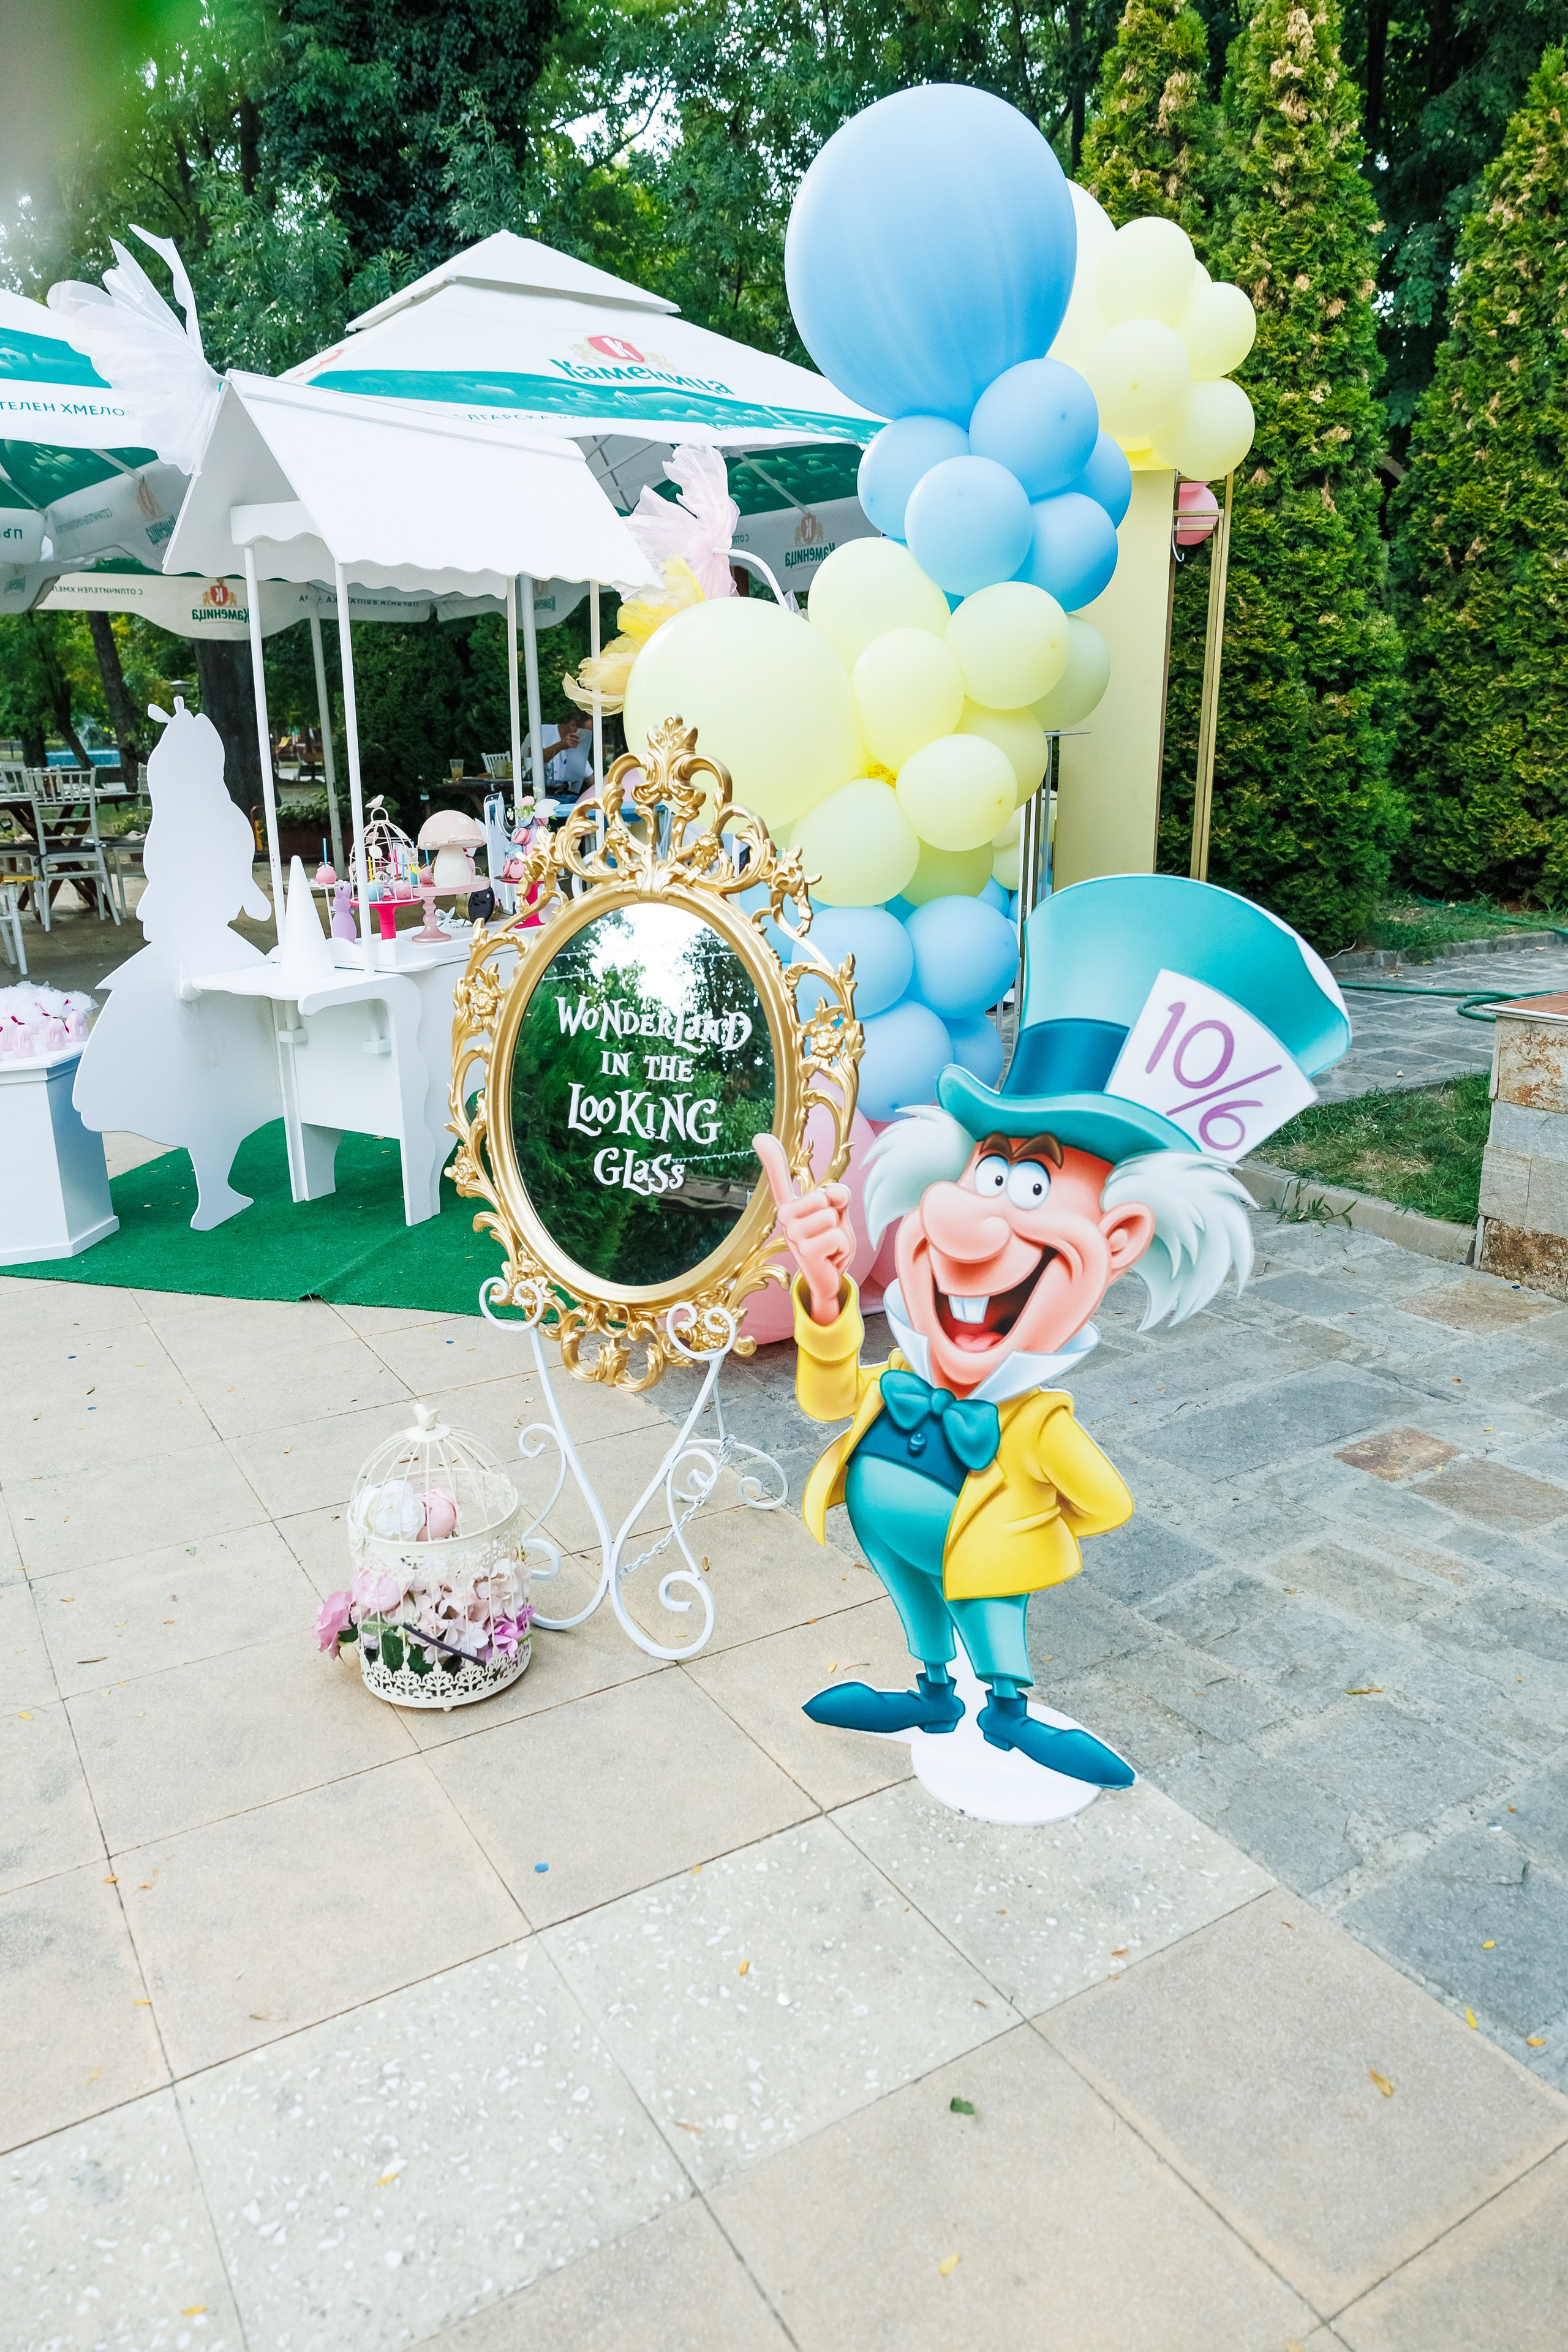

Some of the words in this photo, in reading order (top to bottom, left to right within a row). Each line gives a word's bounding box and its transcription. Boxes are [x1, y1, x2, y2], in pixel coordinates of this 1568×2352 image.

[549, 358, 736, 395] Каменица
[60, 403, 136, 417] ХМЕЛО
[600, 1050, 633, 1077] IN
[643, 1054, 695, 1082] THE
